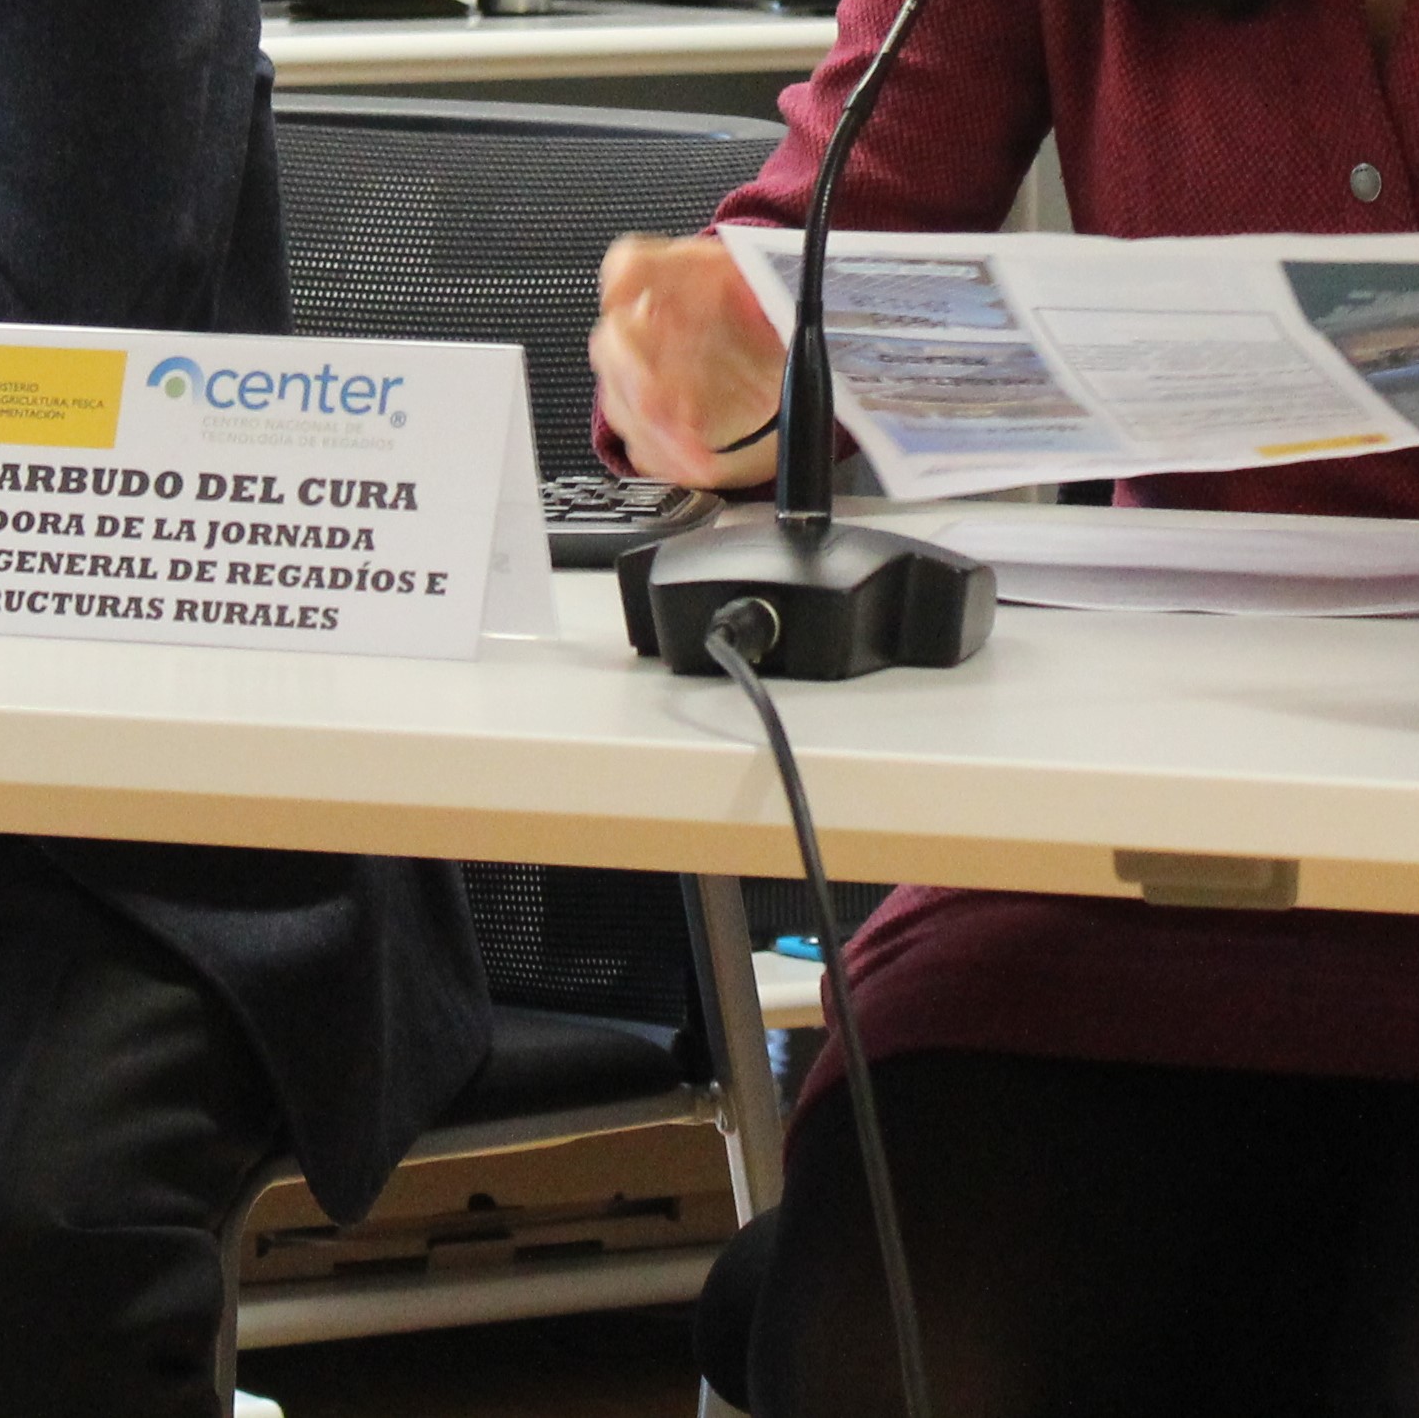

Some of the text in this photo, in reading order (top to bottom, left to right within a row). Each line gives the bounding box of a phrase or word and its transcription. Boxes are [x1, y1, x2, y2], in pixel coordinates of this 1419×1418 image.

[71, 399, 104, 409] PESCA
[202, 416, 363, 434] CENTRO NACIONAL DE
[298, 437, 315, 448] DE
[195, 472, 285, 505] DEL
[297, 477, 418, 511] CURA
[94, 514, 145, 539] DE
[152, 517, 197, 542] LA
[204, 520, 375, 551] JORNADA
[167, 558, 218, 583] DE
[225, 561, 416, 594] REGADÍOS
[425, 572, 448, 596] E
[173, 599, 339, 630] RURALES
